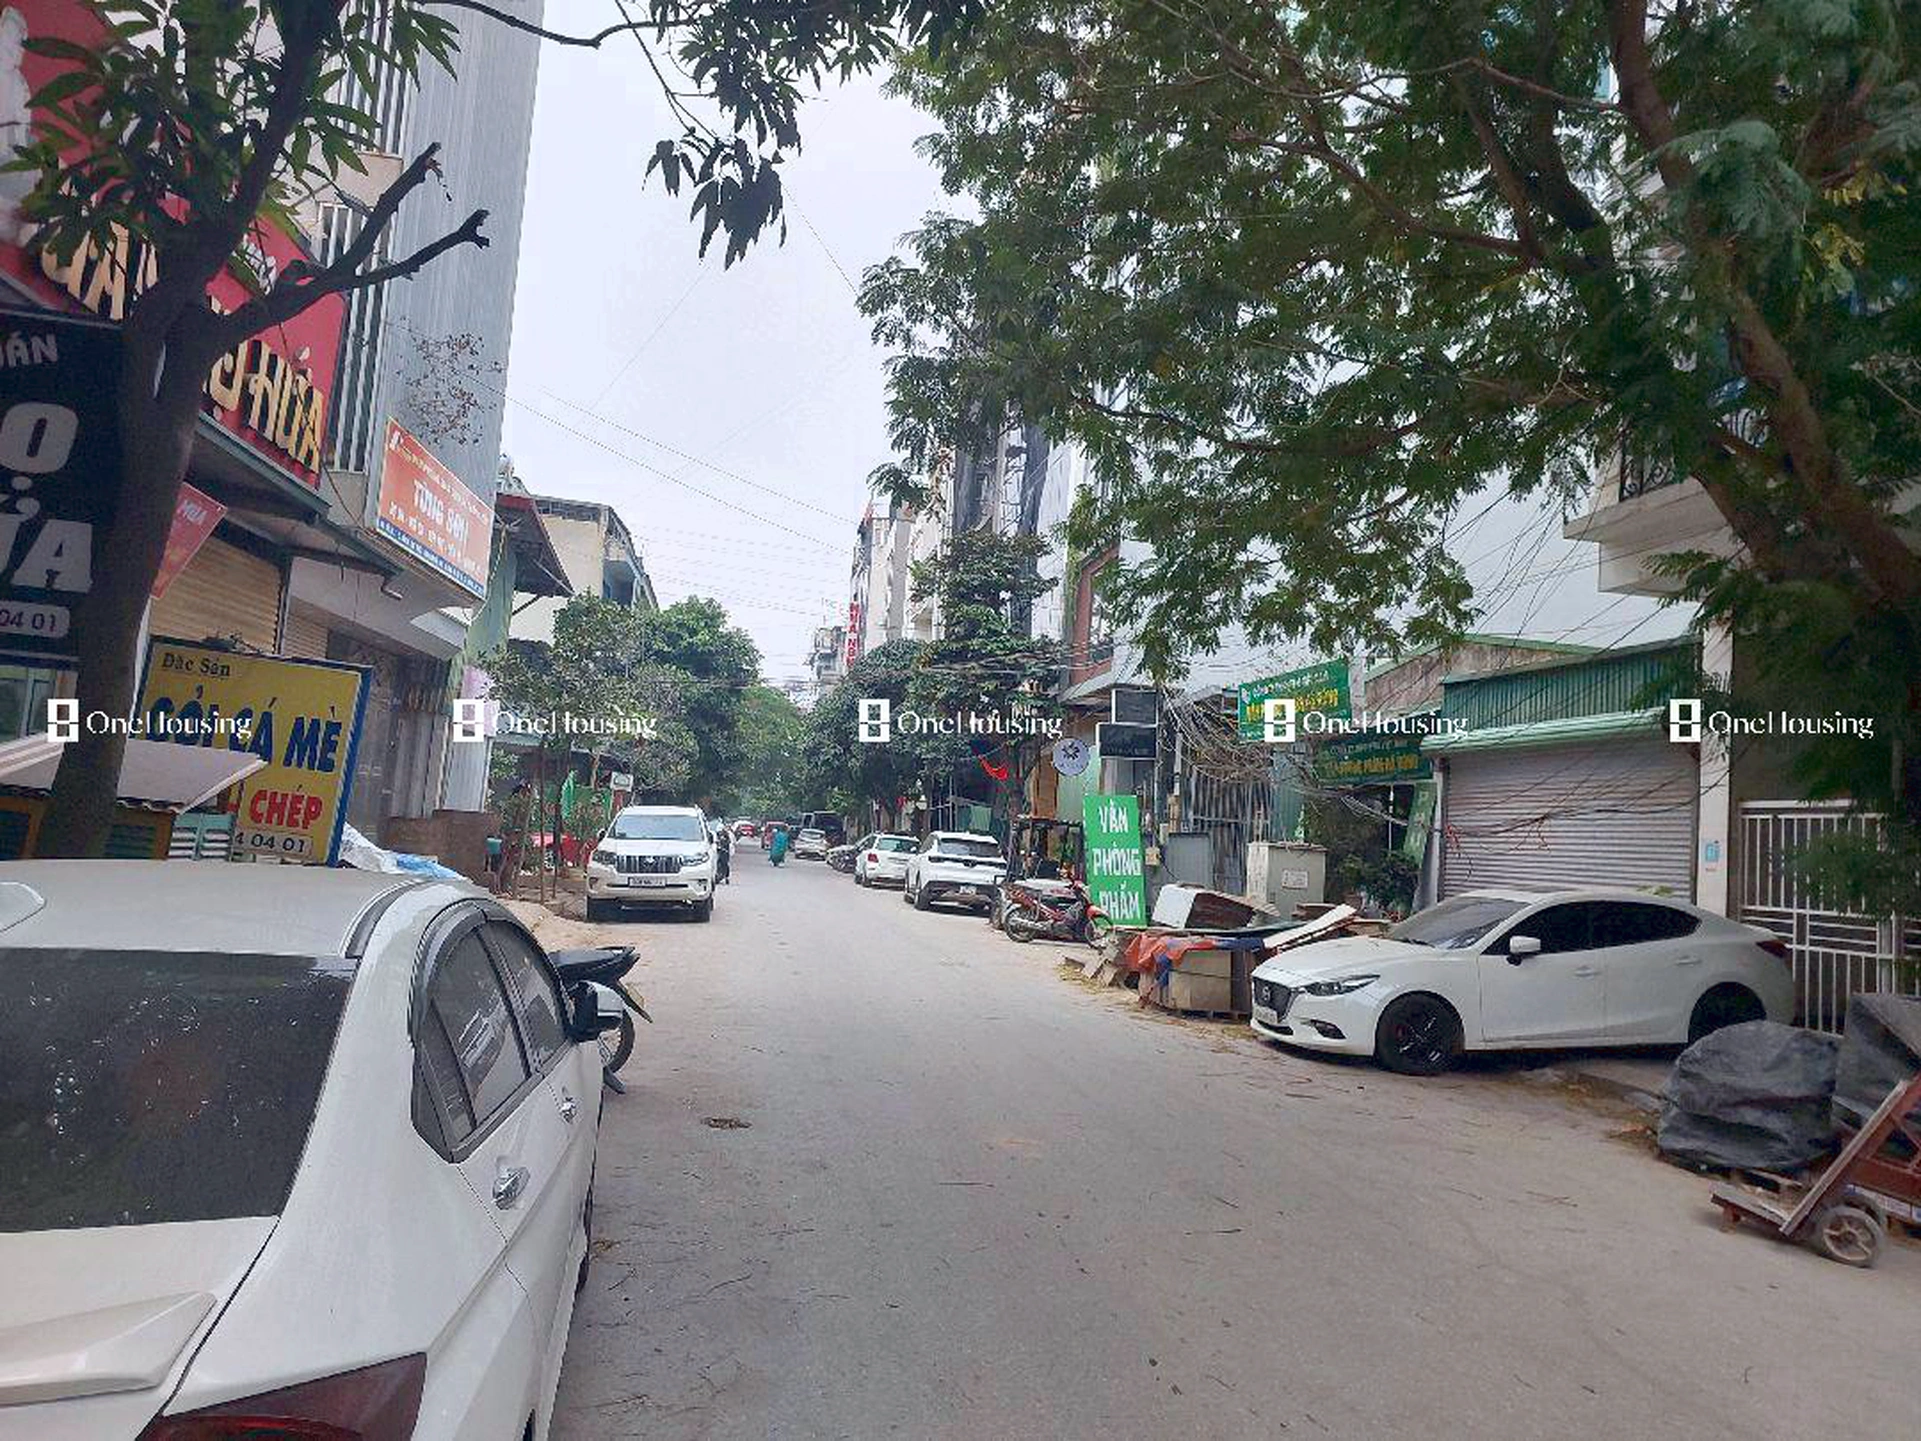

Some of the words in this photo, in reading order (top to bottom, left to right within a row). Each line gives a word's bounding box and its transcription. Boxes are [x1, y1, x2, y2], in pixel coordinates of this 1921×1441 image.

[251, 785, 323, 830] CHÉP
[250, 834, 276, 850] 04
[281, 837, 306, 853] 01
